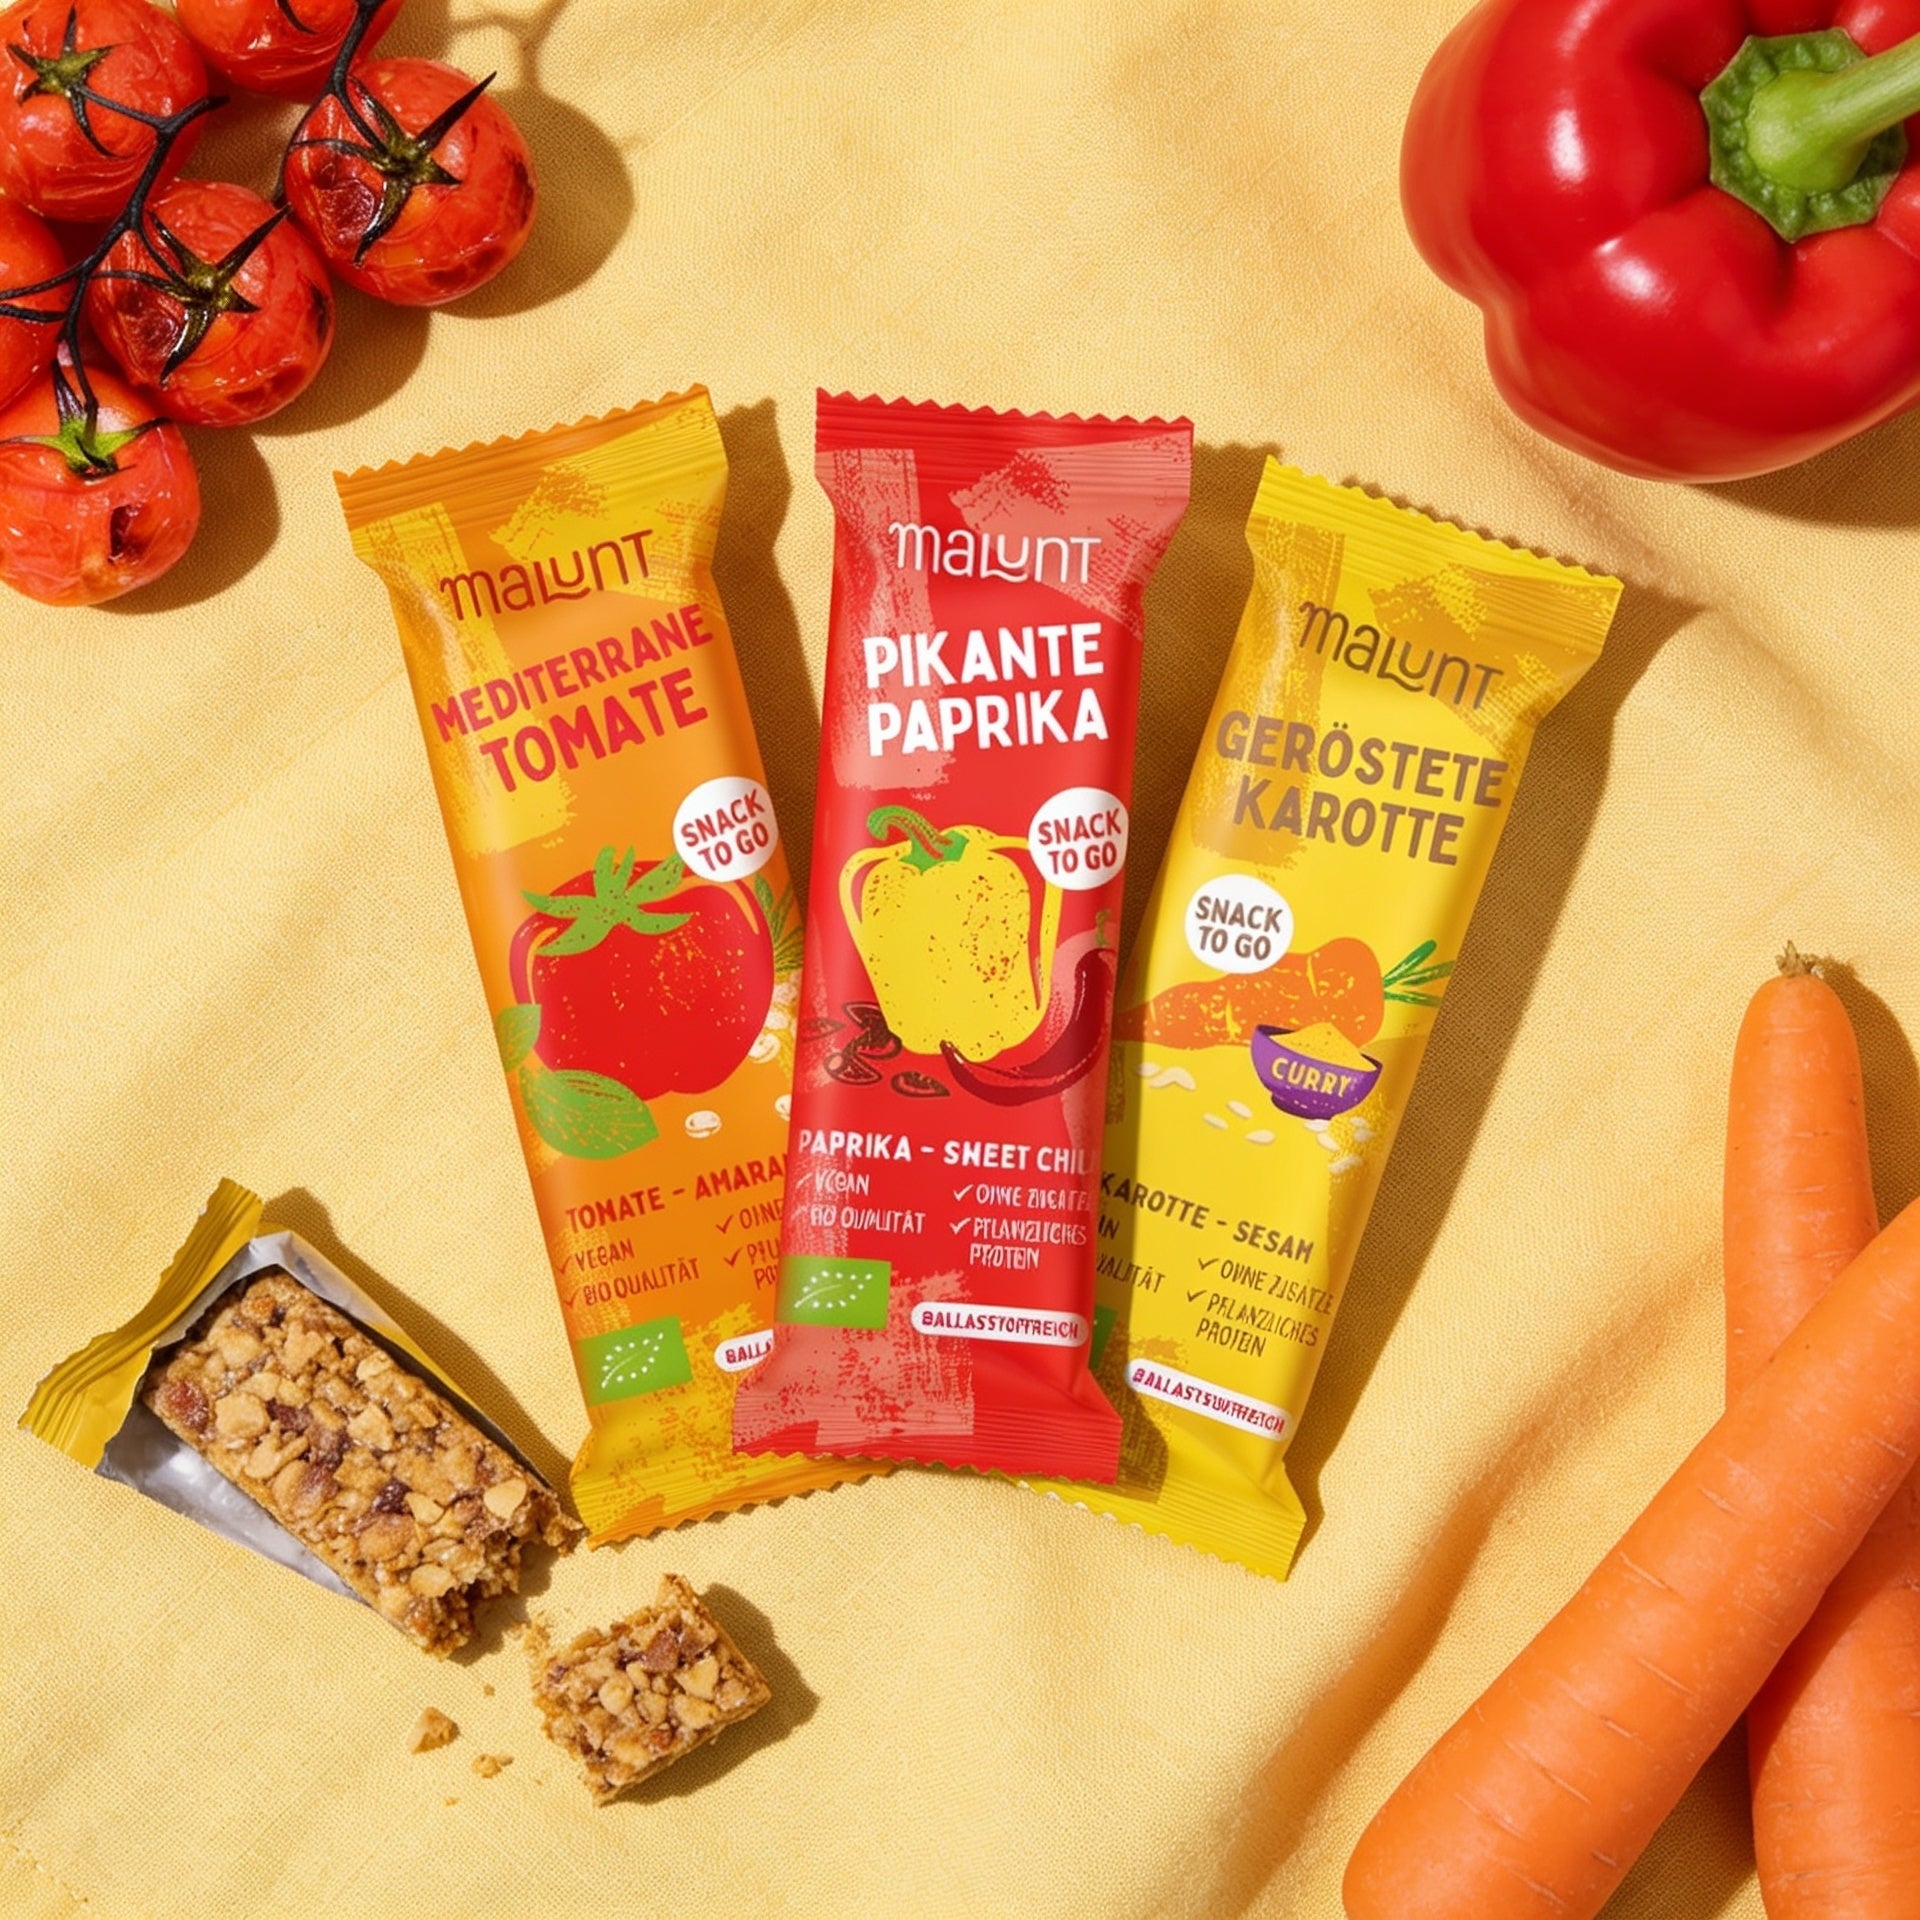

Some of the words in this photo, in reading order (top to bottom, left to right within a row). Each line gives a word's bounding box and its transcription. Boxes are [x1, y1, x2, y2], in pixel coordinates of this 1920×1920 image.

[430, 602, 714, 743] MEDITERRANE
[862, 621, 1105, 690] PIKANTE
[479, 666, 709, 793] TOMATE
[866, 687, 1109, 758] PAPRIKA
[1215, 709, 1509, 809] GERÖSTETE
[680, 788, 766, 848] SNACK
[1037, 807, 1122, 846] SNACK
[1231, 774, 1466, 867] KAROTTE
[697, 840, 733, 872] TO
[735, 821, 769, 855] GO
[1047, 848, 1078, 875] TO
[1084, 840, 1117, 870] GO
[1194, 895, 1284, 934] SNACK
[1198, 925, 1228, 954] TO
[1234, 933, 1271, 961] GO
[1271, 1057, 1352, 1098] CURRY
[798, 1129, 912, 1162] PAPRIKA
[695, 1154, 788, 1201] AMARA
[1100, 1171, 1210, 1230] KAROTTE
[1232, 1220, 1315, 1265] SESAM
